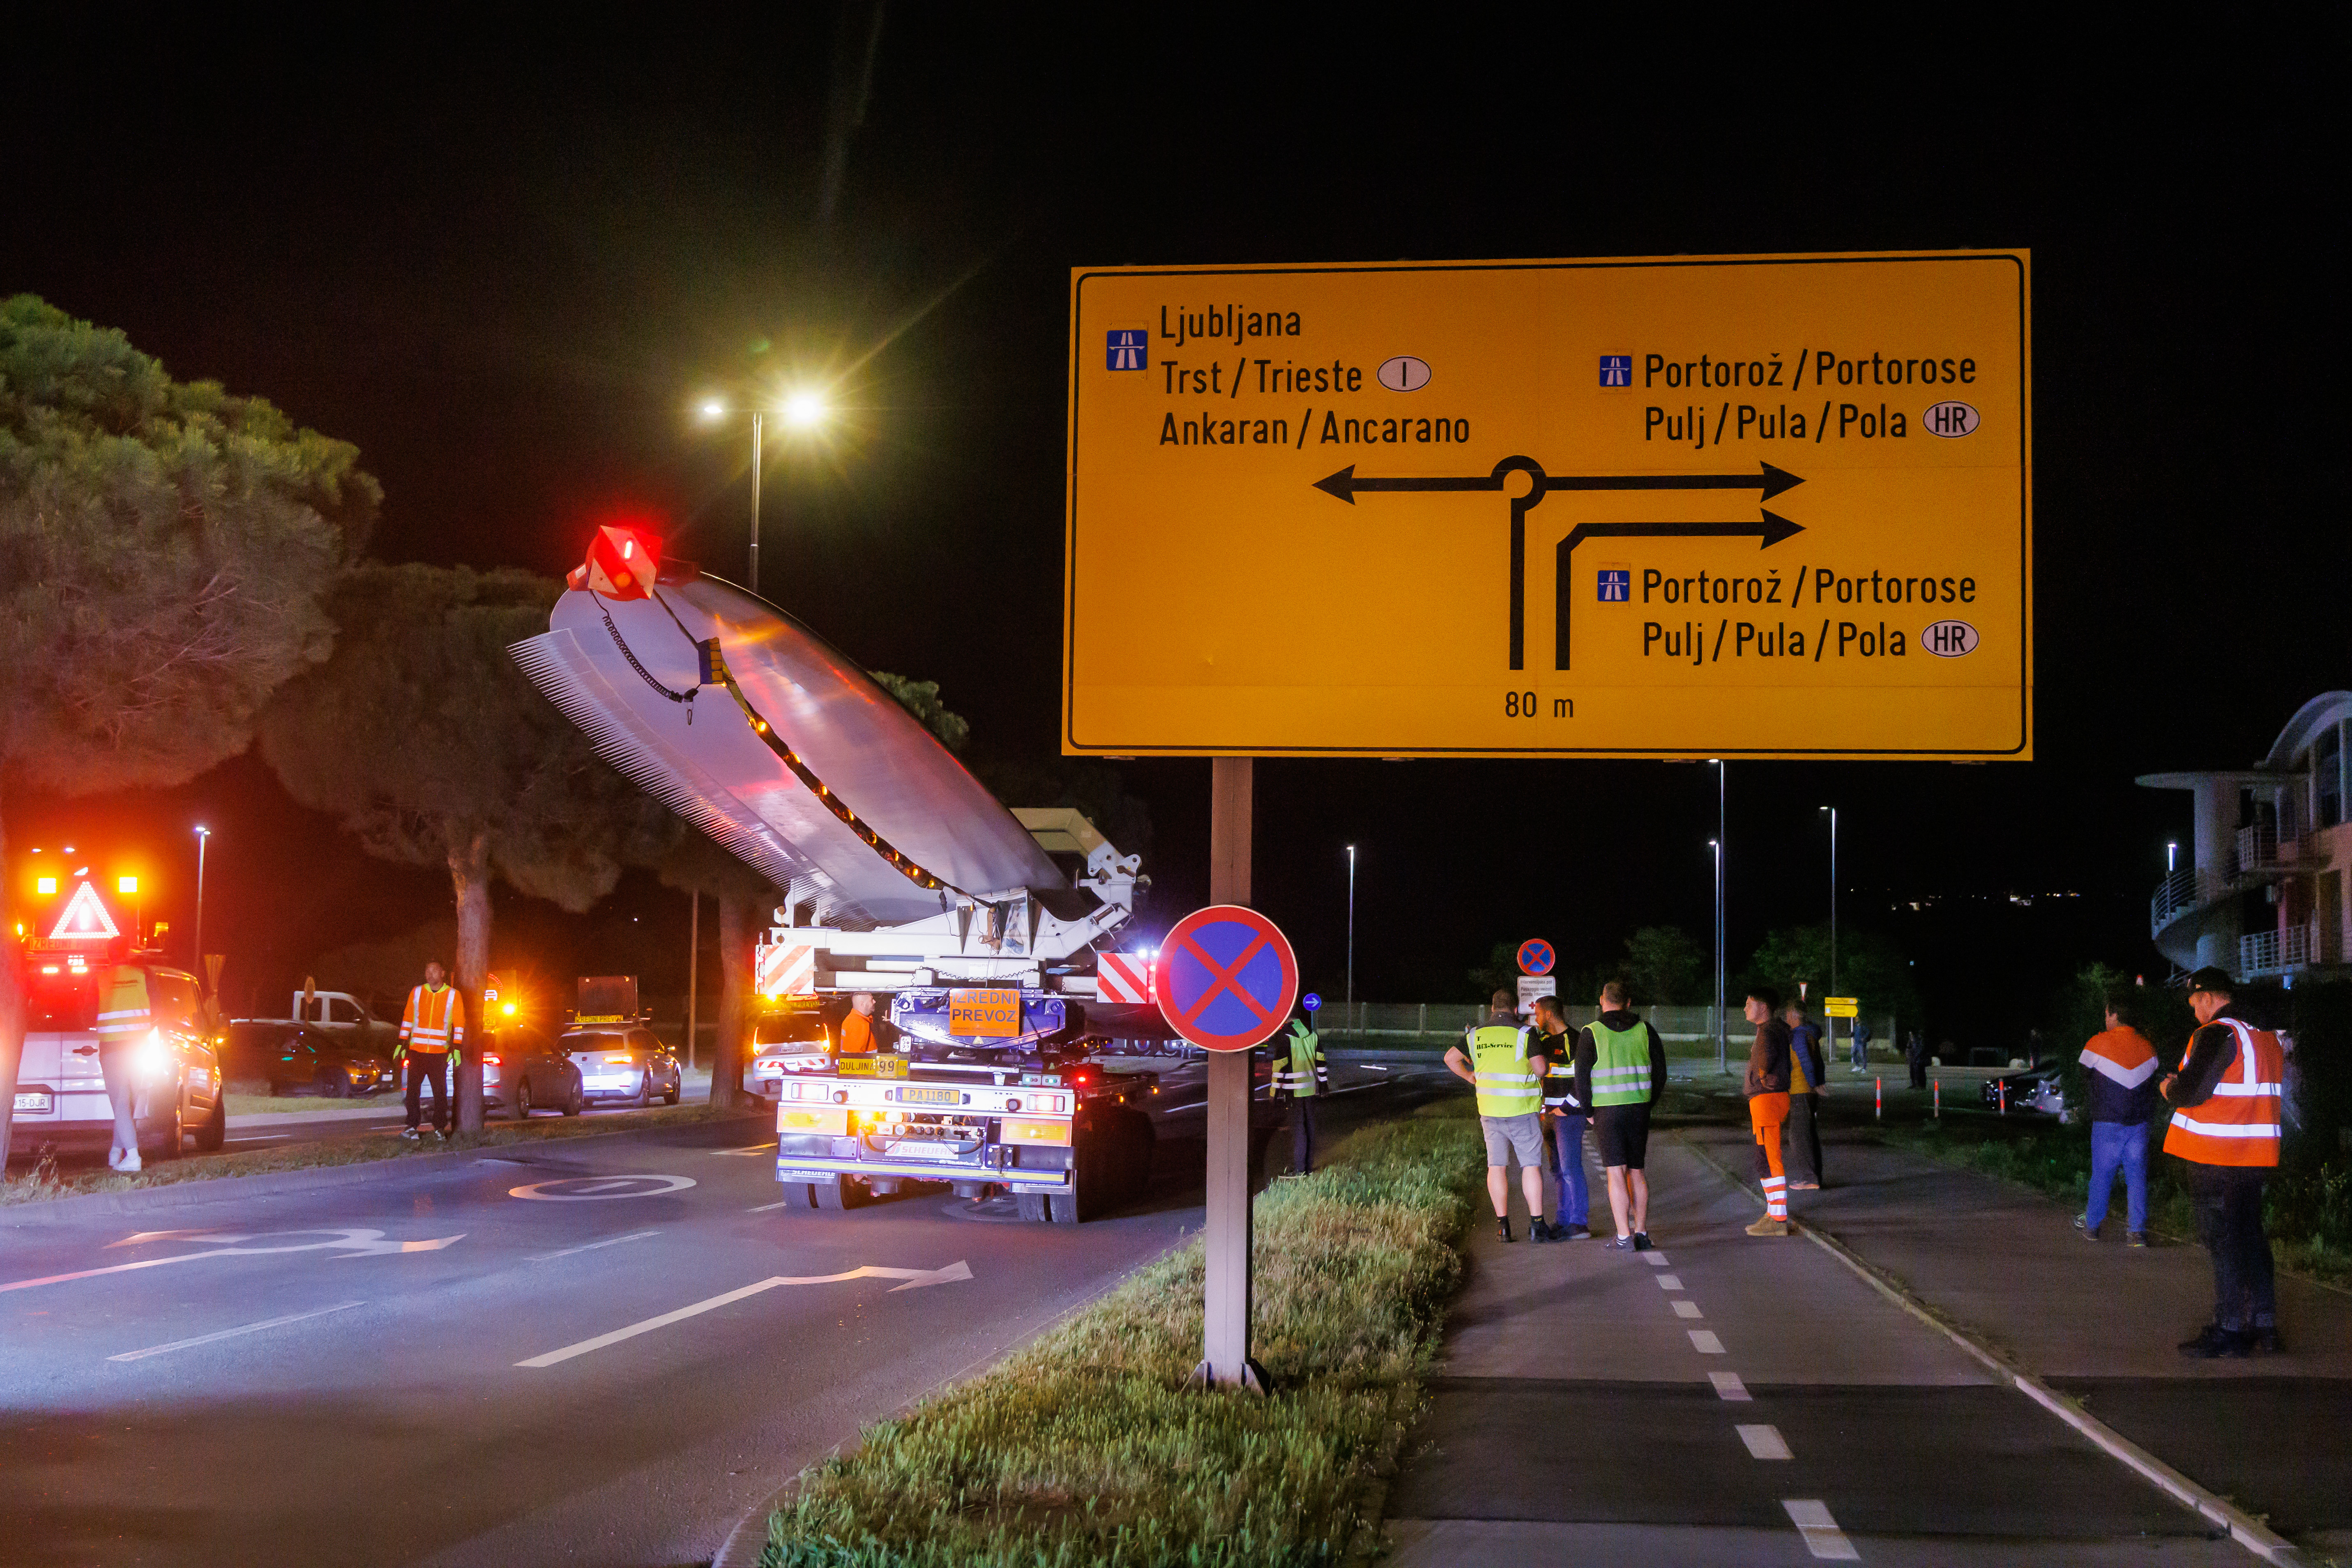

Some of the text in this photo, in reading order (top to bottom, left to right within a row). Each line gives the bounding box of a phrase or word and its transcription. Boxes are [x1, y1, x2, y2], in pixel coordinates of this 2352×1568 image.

[1161, 304, 1300, 347] Ljubljana
[1161, 360, 1222, 394] Trst
[1254, 360, 1361, 393] Trieste
[1402, 361, 1407, 387] I
[1646, 353, 1783, 388] Portorož
[1817, 351, 1976, 385] Portorose
[1160, 412, 1287, 445] Ankaran
[1320, 411, 1469, 444] Ancarano
[1646, 406, 1704, 449] Pulj
[1738, 405, 1806, 439] Pula
[1840, 403, 1906, 438] Pola
[1935, 407, 1966, 433] HR
[1643, 569, 1781, 603] Portorož
[1816, 569, 1976, 603] Portorose
[1644, 622, 1702, 666] Pulj
[1736, 622, 1804, 657] Pula
[1838, 622, 1905, 657] Pola
[1934, 626, 1965, 652] HR
[1505, 691, 1573, 718] 80 m
[951, 991, 1016, 1004] IZREDNI
[952, 1009, 1016, 1022] PREVOZ
[879, 1061, 894, 1073] 99
